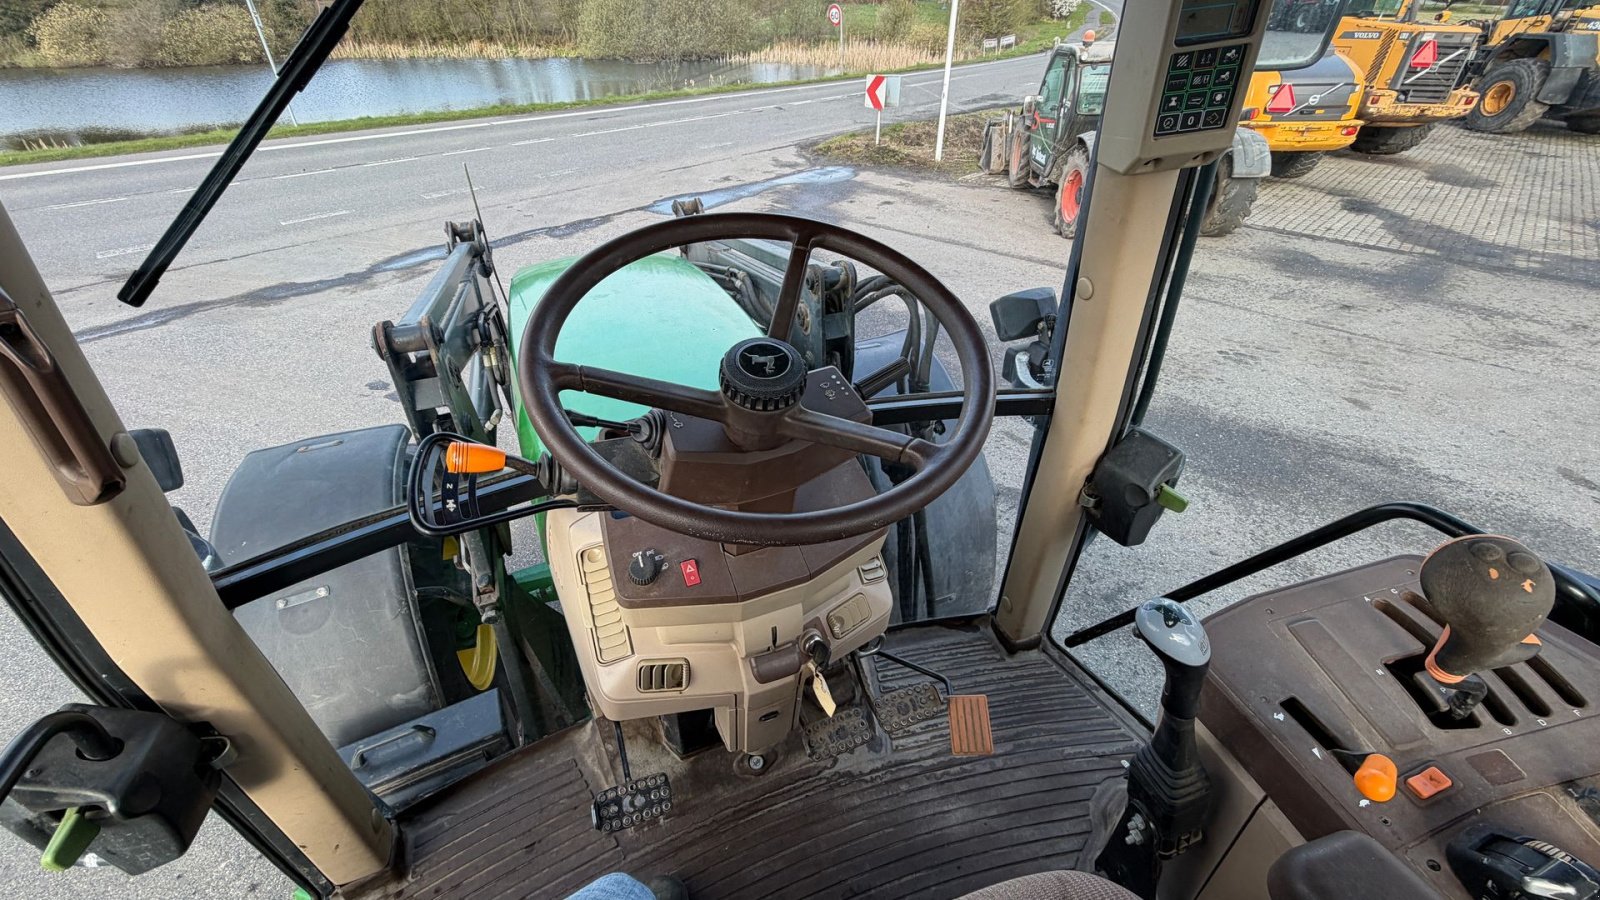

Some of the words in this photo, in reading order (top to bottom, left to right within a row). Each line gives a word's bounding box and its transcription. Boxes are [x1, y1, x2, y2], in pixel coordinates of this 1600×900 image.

[1187, 116, 1195, 125] 0
[1572, 709, 1581, 717] F
[1537, 719, 1547, 727] D
